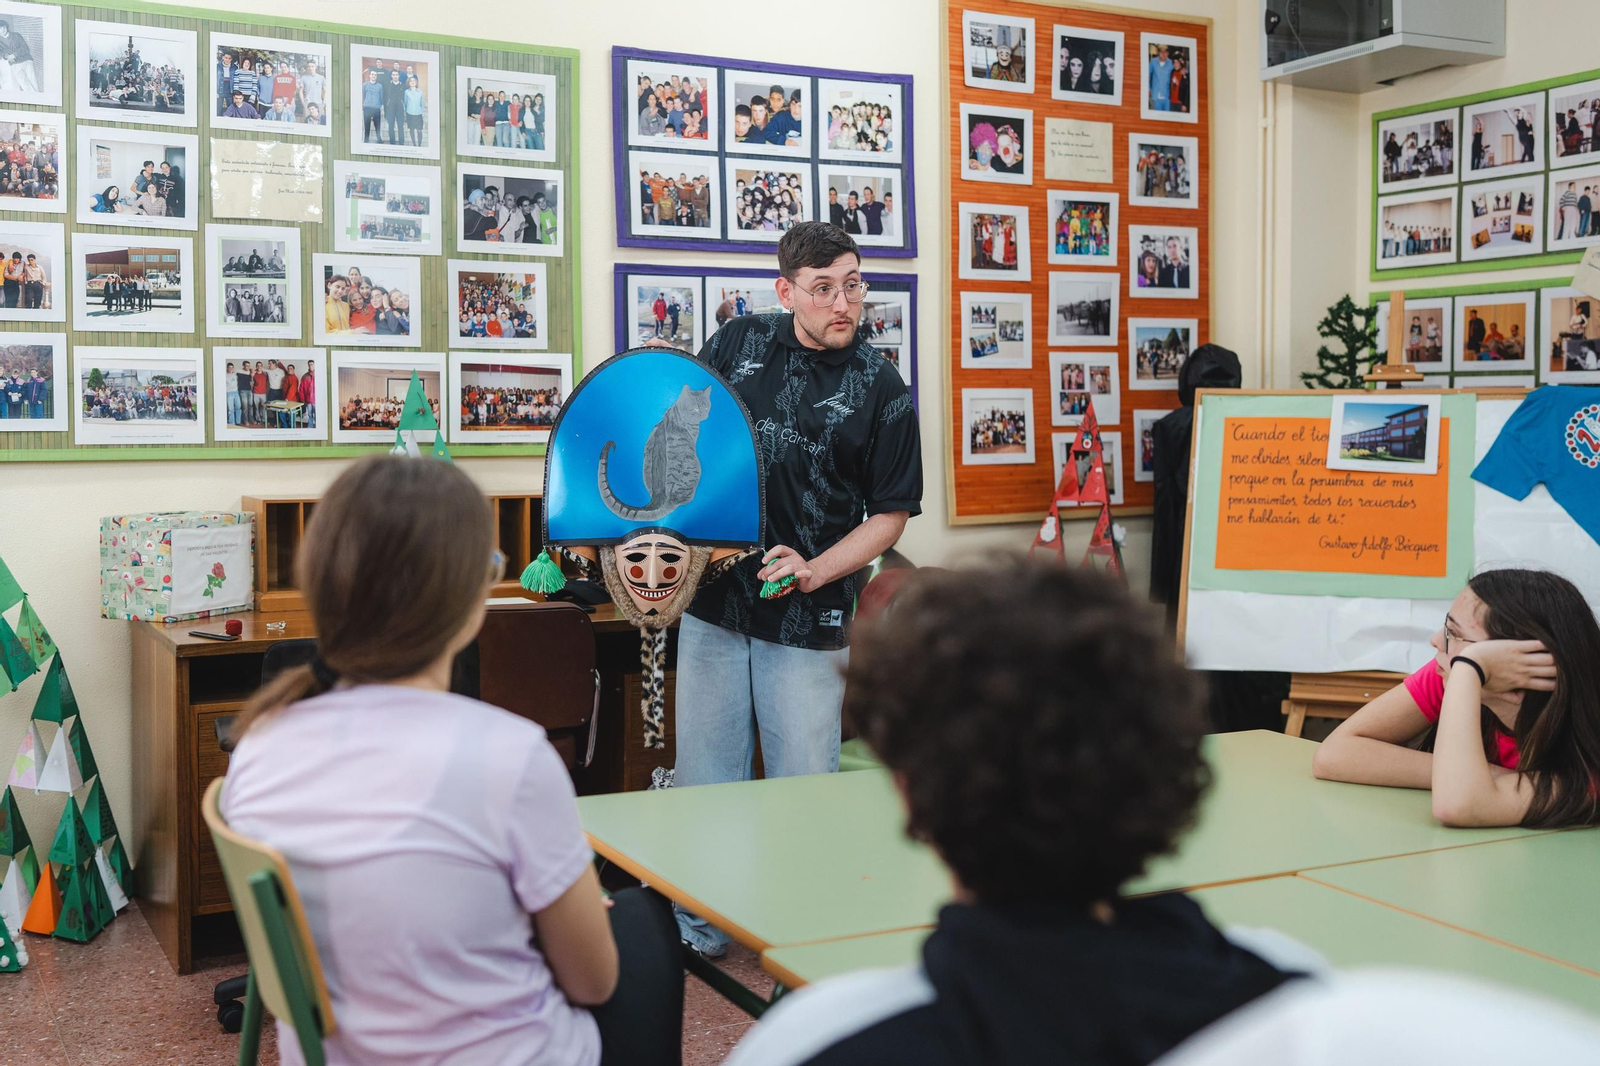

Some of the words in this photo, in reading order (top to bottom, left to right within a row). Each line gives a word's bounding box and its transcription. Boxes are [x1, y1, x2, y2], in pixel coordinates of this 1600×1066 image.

[755, 417, 775, 434] de
[1291, 425, 1305, 441] el
[1231, 454, 1249, 464] me
[1229, 474, 1269, 492] porque
[1292, 469, 1305, 486] la
[1309, 472, 1365, 492] penumbra
[1372, 476, 1387, 487] de
[1392, 476, 1414, 488] mis
[1303, 493, 1332, 506] todos
[1337, 495, 1354, 507] los
[1358, 494, 1416, 509] recuerdos
[1227, 514, 1243, 524] me
[1248, 508, 1300, 525] hablarán
[1307, 511, 1321, 524] de
[1318, 535, 1358, 549] Gustavo
[1351, 536, 1392, 560] Adolfo
[1395, 534, 1440, 560] Bécquer
